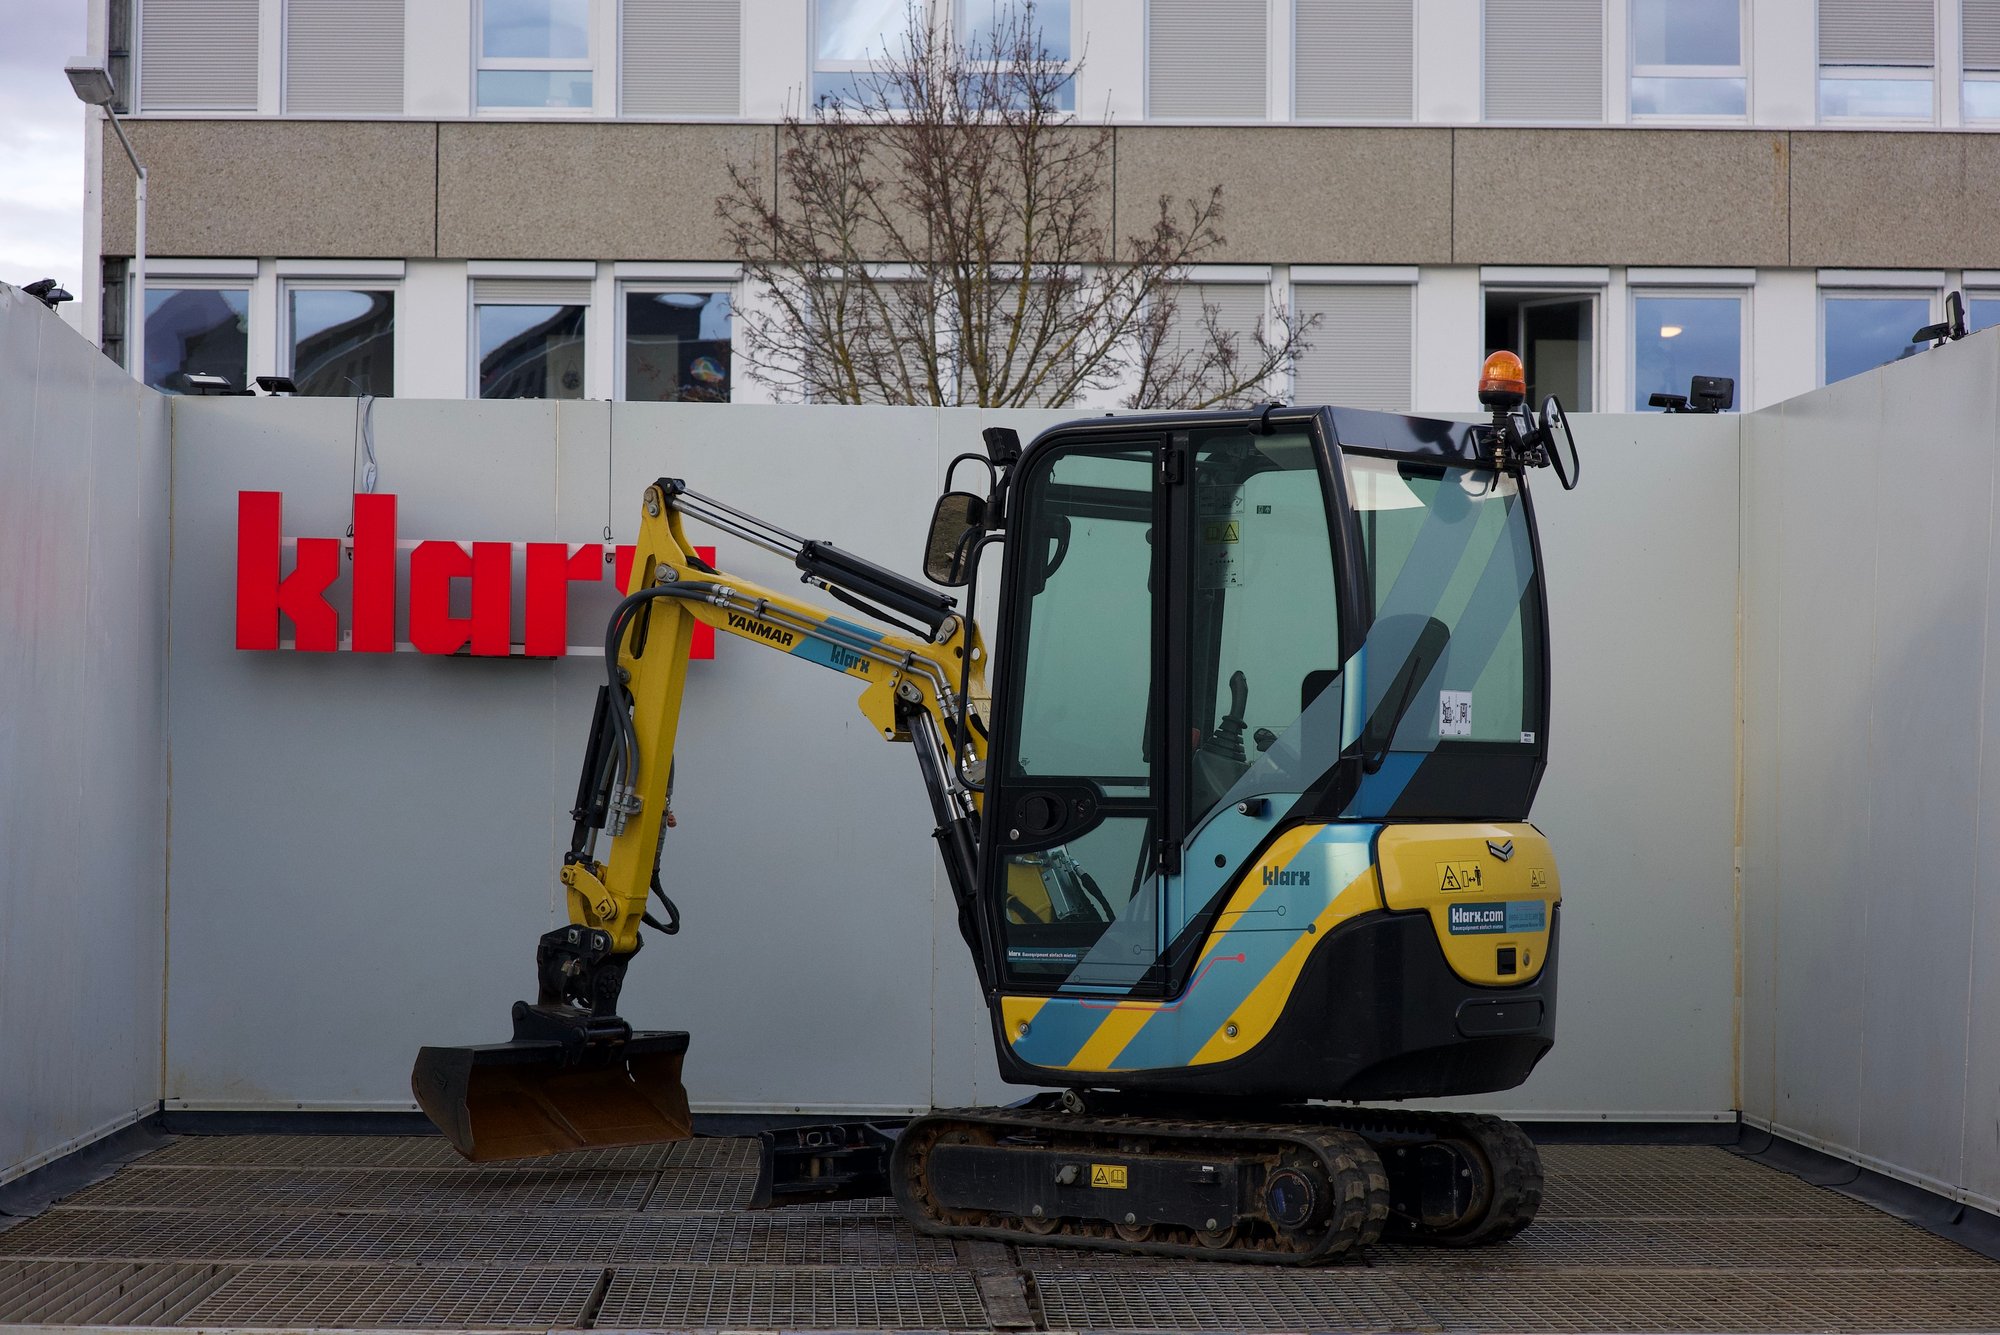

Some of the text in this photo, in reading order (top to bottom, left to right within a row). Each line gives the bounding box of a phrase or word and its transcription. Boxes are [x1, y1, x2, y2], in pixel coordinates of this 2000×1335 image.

[728, 612, 793, 646] YANMAR
[830, 645, 870, 673] klarx
[1263, 866, 1310, 886] klarx
[1452, 908, 1503, 923] klarx.com
